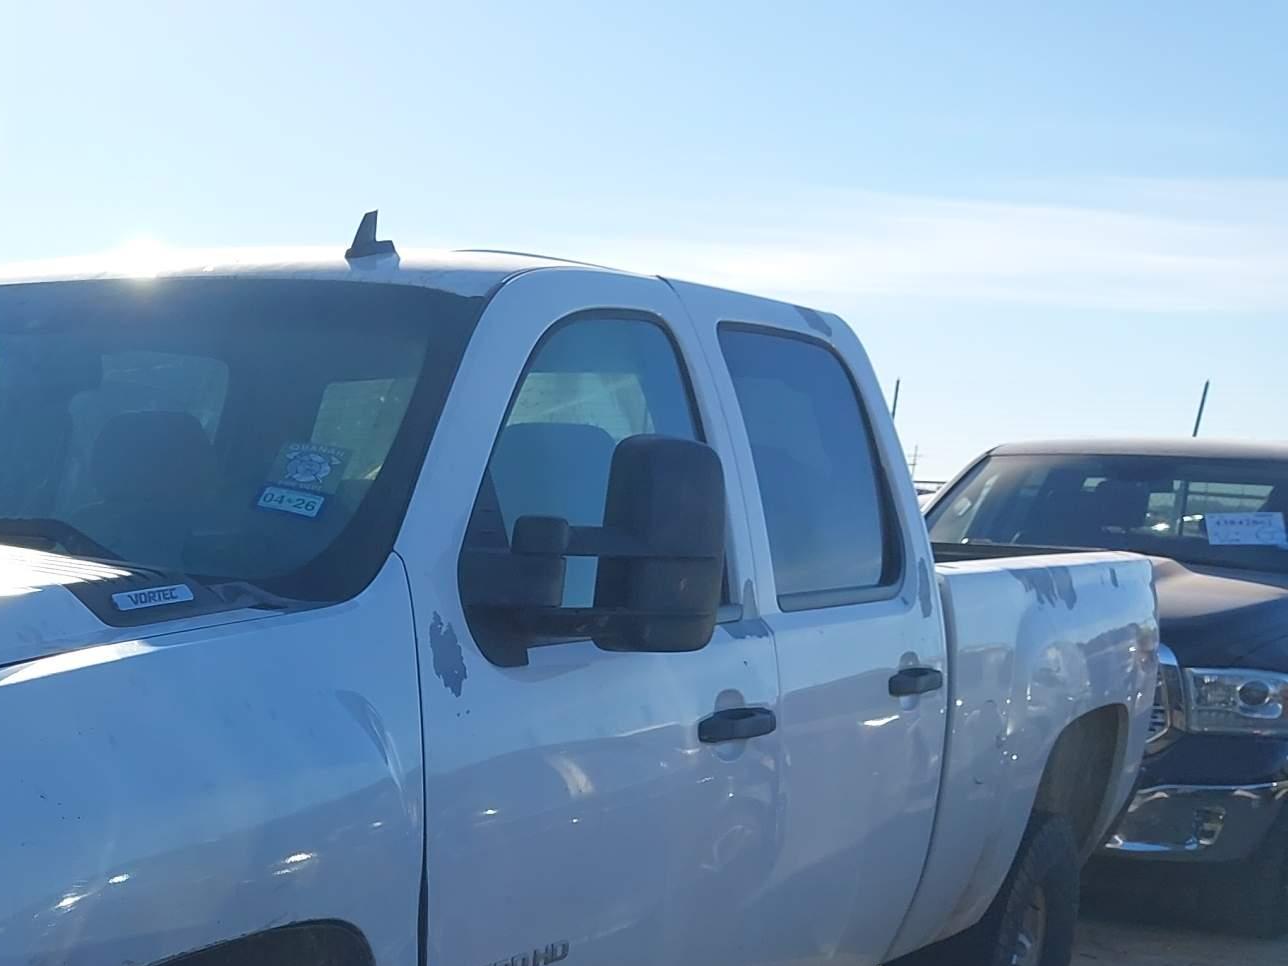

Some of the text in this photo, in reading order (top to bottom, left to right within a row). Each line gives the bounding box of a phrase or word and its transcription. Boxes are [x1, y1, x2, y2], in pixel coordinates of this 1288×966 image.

[263, 493, 318, 511] 04 26
[128, 588, 178, 606] VORTEC
